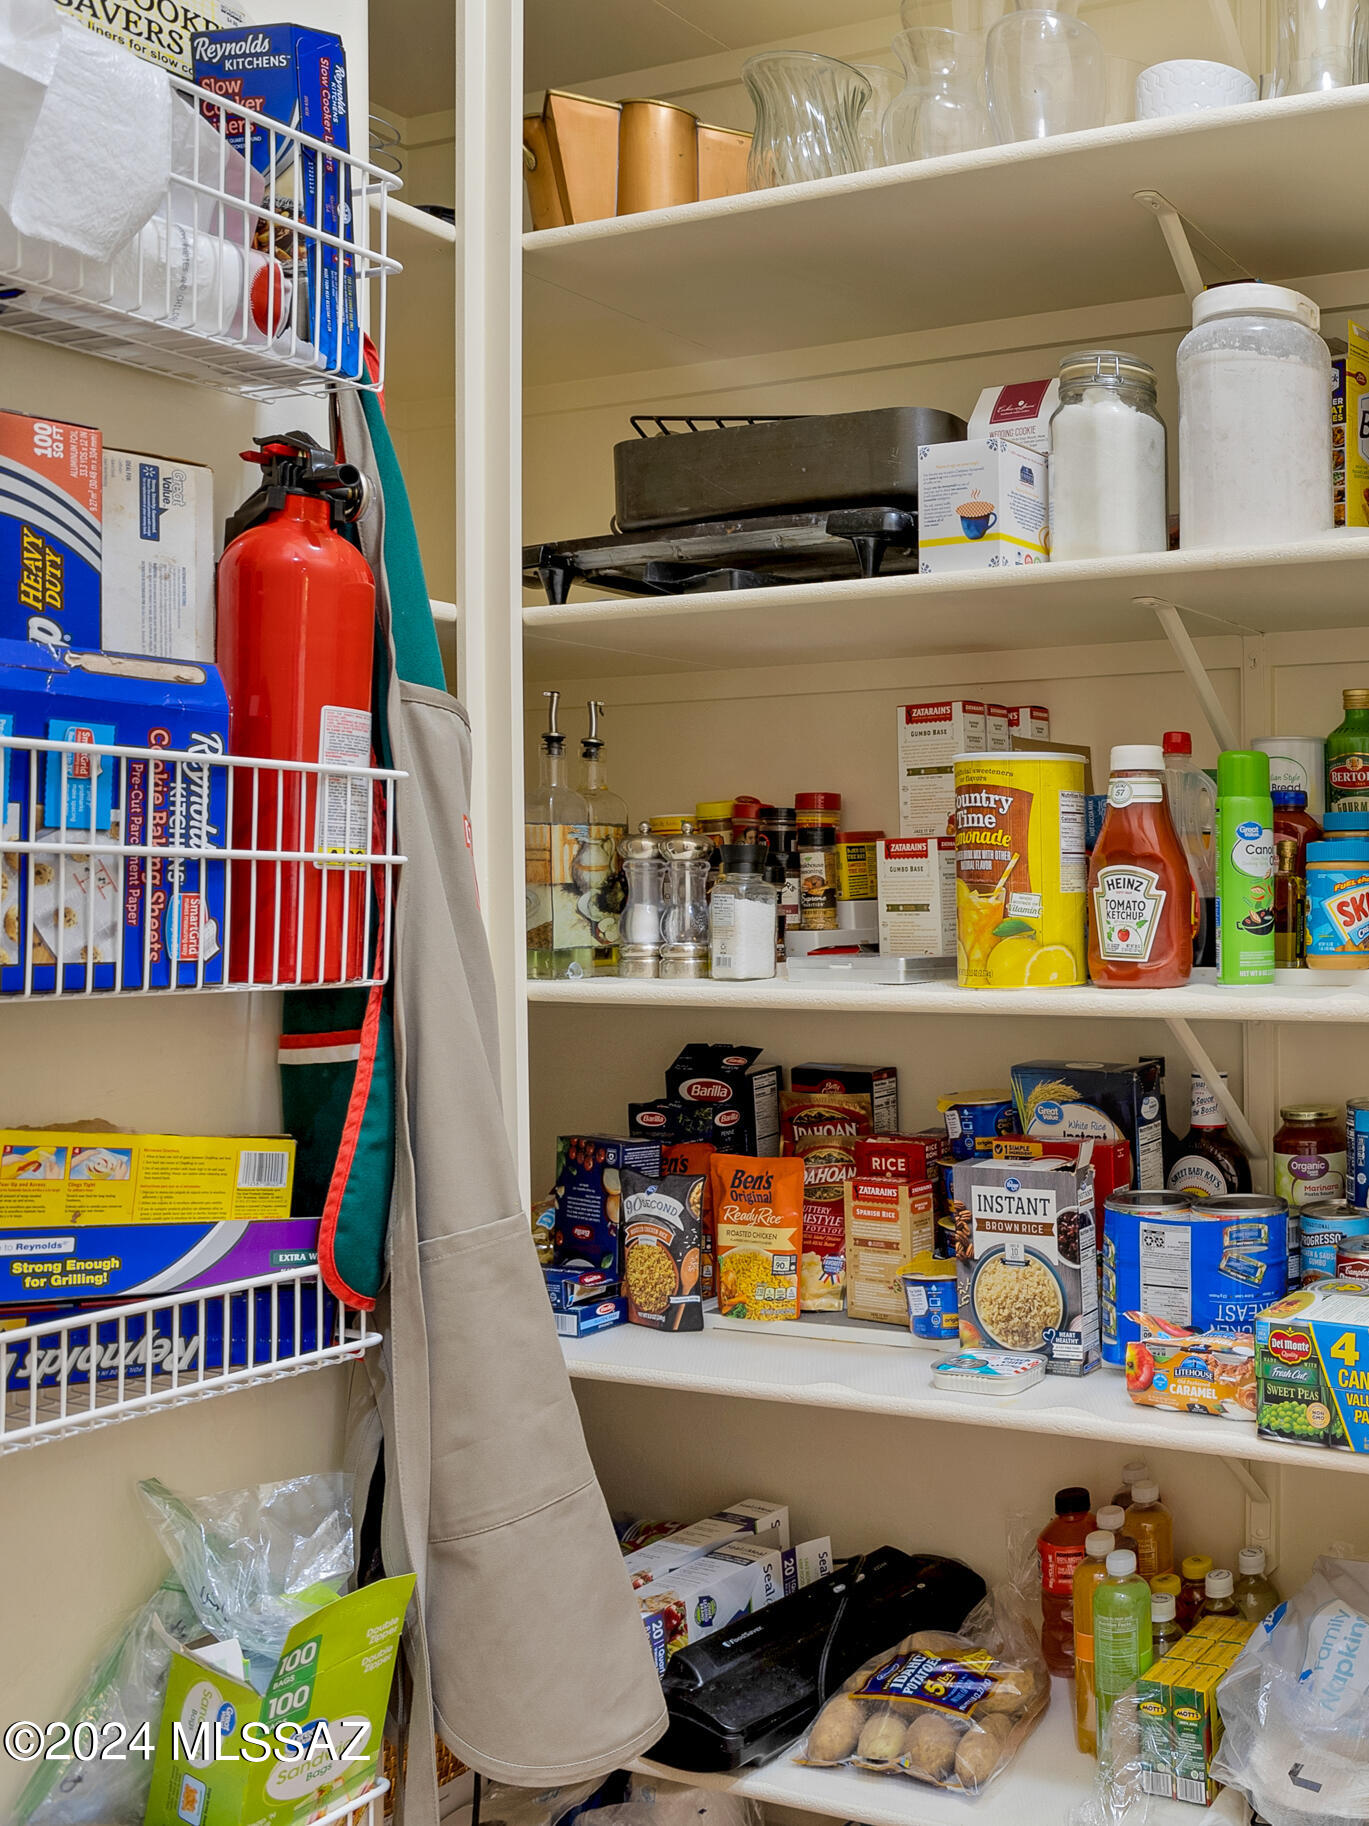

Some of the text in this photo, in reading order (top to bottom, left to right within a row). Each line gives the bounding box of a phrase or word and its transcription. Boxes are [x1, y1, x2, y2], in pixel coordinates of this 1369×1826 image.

[87, 21, 179, 69] liners for slow
[194, 33, 270, 63] Reynolds
[225, 56, 287, 71] KITCHENS
[202, 79, 241, 95] Slow
[333, 64, 346, 116] Reynolds
[331, 81, 339, 123] KITCHENS
[320, 57, 334, 173] Slow Cooker Lers
[1016, 425, 1037, 436] COOKIE
[33, 422, 53, 459] 100
[53, 425, 64, 459] SQ FT
[162, 476, 174, 505] Value
[171, 469, 188, 508] Great
[19, 526, 46, 610] HEAVY
[45, 548, 64, 609] DUTY
[911, 705, 951, 717] ZATARAIN'S
[910, 728, 948, 738] GUMBO BASE
[130, 763, 144, 814] Pre-Cut
[956, 789, 1014, 815] ountry
[956, 809, 996, 829] Time
[1238, 824, 1260, 835] Great
[890, 841, 928, 853] ZATARAIN'S
[889, 864, 924, 873] GUMBO BASE
[1106, 878, 1145, 893] HEINZ
[1334, 879, 1356, 892] FUEL
[126, 887, 141, 926] Paper
[1105, 899, 1147, 912] TOMATO
[1106, 911, 1145, 921] KETCHUP
[690, 1083, 729, 1098] Barilla
[1038, 1106, 1058, 1116] Great
[793, 1123, 858, 1141] IDAHOAN
[1068, 1120, 1107, 1130] White Rice
[1009, 1144, 1030, 1152] SIMPLE
[871, 1156, 907, 1172] RICE
[1187, 1166, 1204, 1177] BABY
[1290, 1160, 1326, 1173] Organic
[730, 1168, 775, 1191] Ben's
[1304, 1183, 1340, 1192] Marinara
[730, 1189, 773, 1206] Original
[858, 1185, 898, 1197] ZATARAIN'S
[625, 1197, 679, 1217] 90 SECOND
[856, 1207, 896, 1219] SPANISH RICE
[977, 1193, 1051, 1217] INSTANT
[726, 1229, 778, 1241] ROASTED CHICKEN
[985, 1220, 1044, 1234] BROWN RICE
[16, 1241, 63, 1252] Reynolds
[278, 1252, 308, 1263] EXTRA
[12, 1257, 121, 1276] Strong Enough
[25, 1272, 109, 1288] for Grilling!
[1272, 1337, 1310, 1353] Del Monte
[1330, 1332, 1360, 1367] 4
[1175, 1368, 1213, 1381] LITEHOUSE
[1169, 1384, 1218, 1400] CARAMEL
[1266, 1383, 1319, 1401] SWEET PEAS
[783, 1558, 794, 1576] 20
[762, 1563, 775, 1597] Seal
[367, 1617, 399, 1637] Double
[369, 1626, 398, 1645] Zipper
[651, 1620, 664, 1640] 20
[278, 1641, 318, 1675] 100
[361, 1645, 393, 1665] Double
[363, 1655, 392, 1674] Zipper
[273, 1674, 295, 1690] BAGS
[924, 1680, 946, 1696] 5
[268, 1684, 310, 1719] 100
[306, 1762, 332, 1782] Bags
